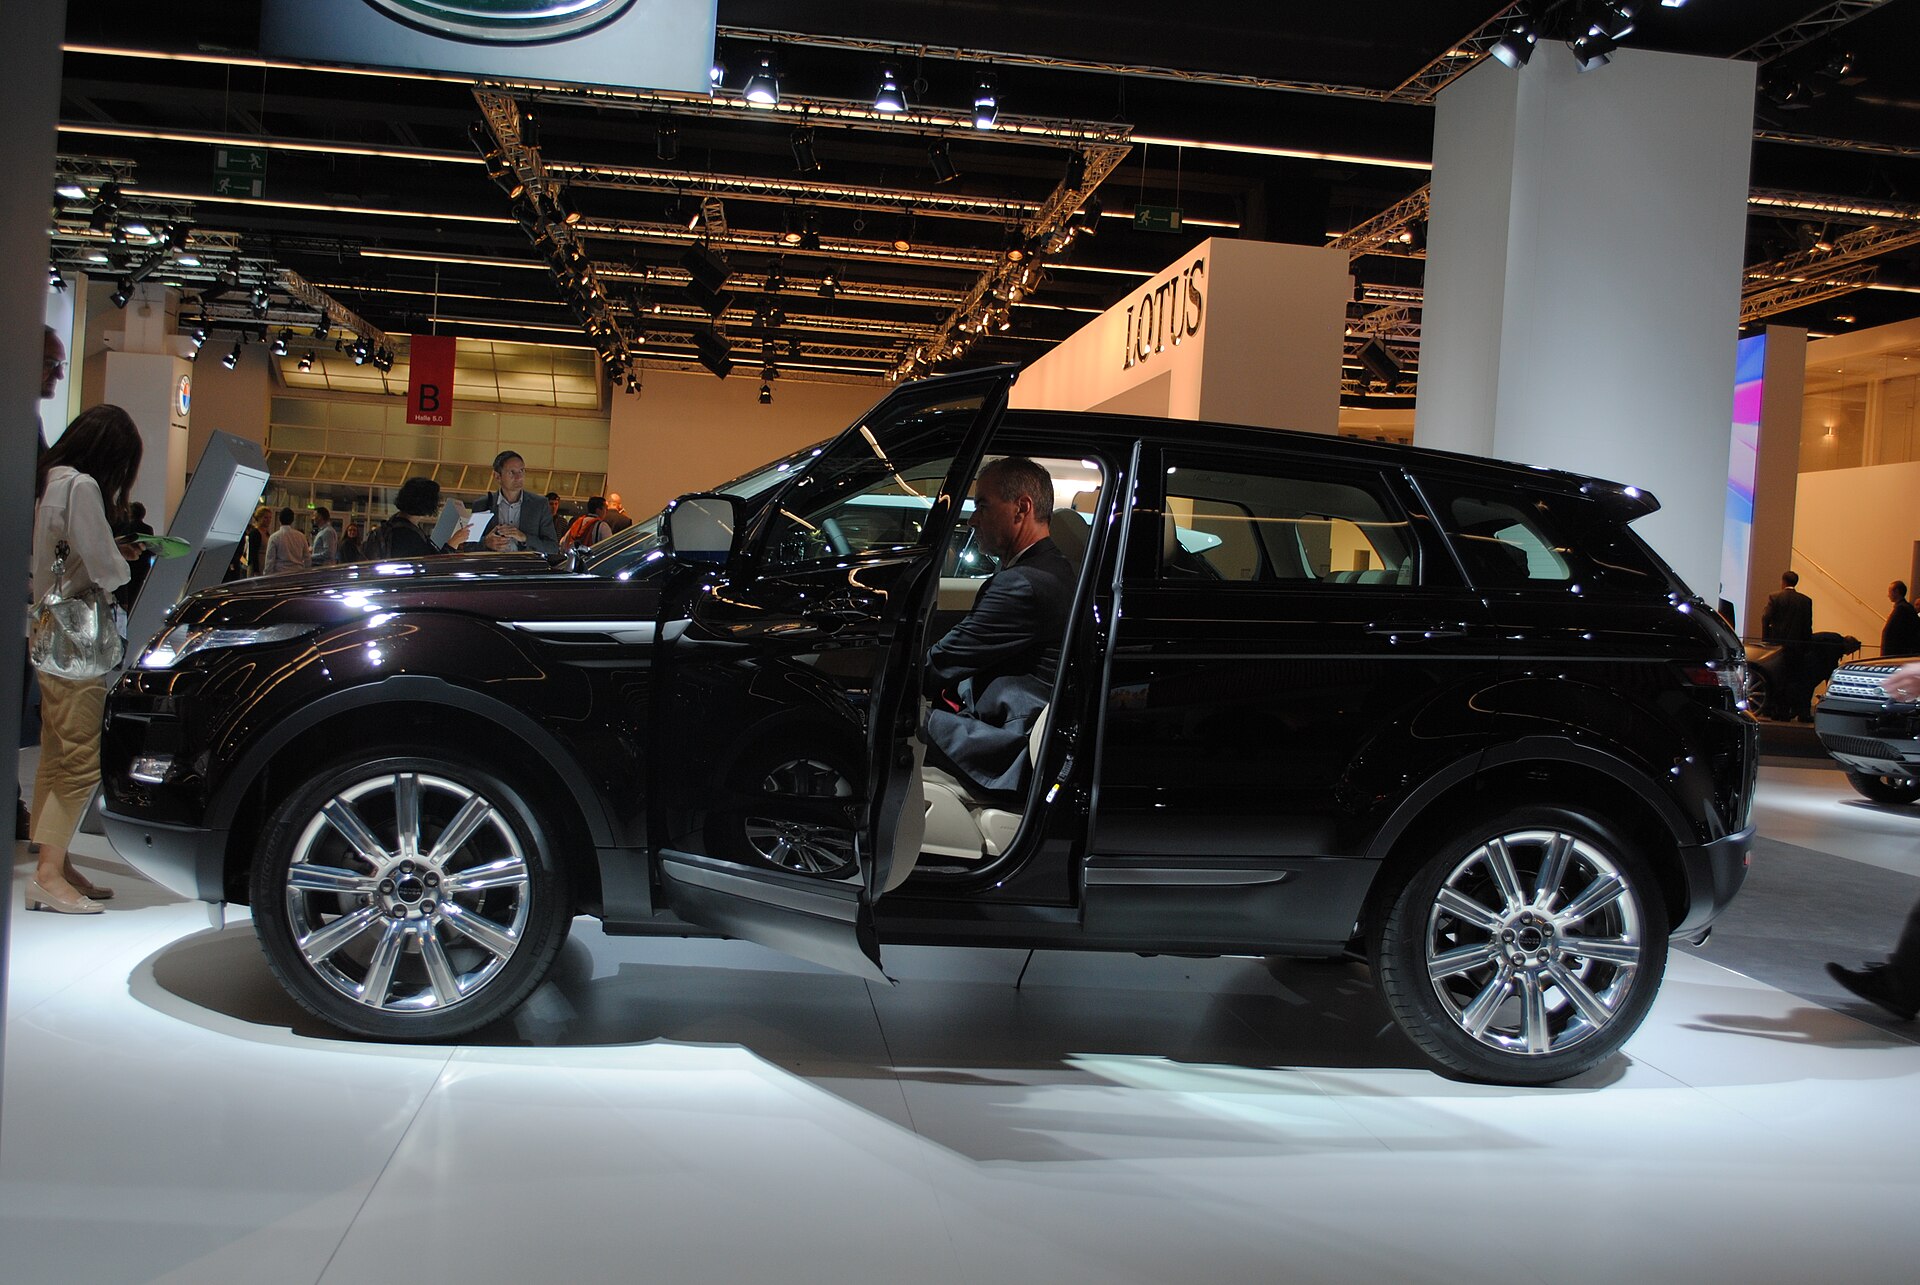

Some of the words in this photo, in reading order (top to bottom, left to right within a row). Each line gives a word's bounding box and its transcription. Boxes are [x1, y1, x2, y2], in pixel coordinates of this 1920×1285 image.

[1122, 257, 1205, 371] LOTUS
[420, 384, 440, 412] B
[415, 414, 431, 422] Halle
